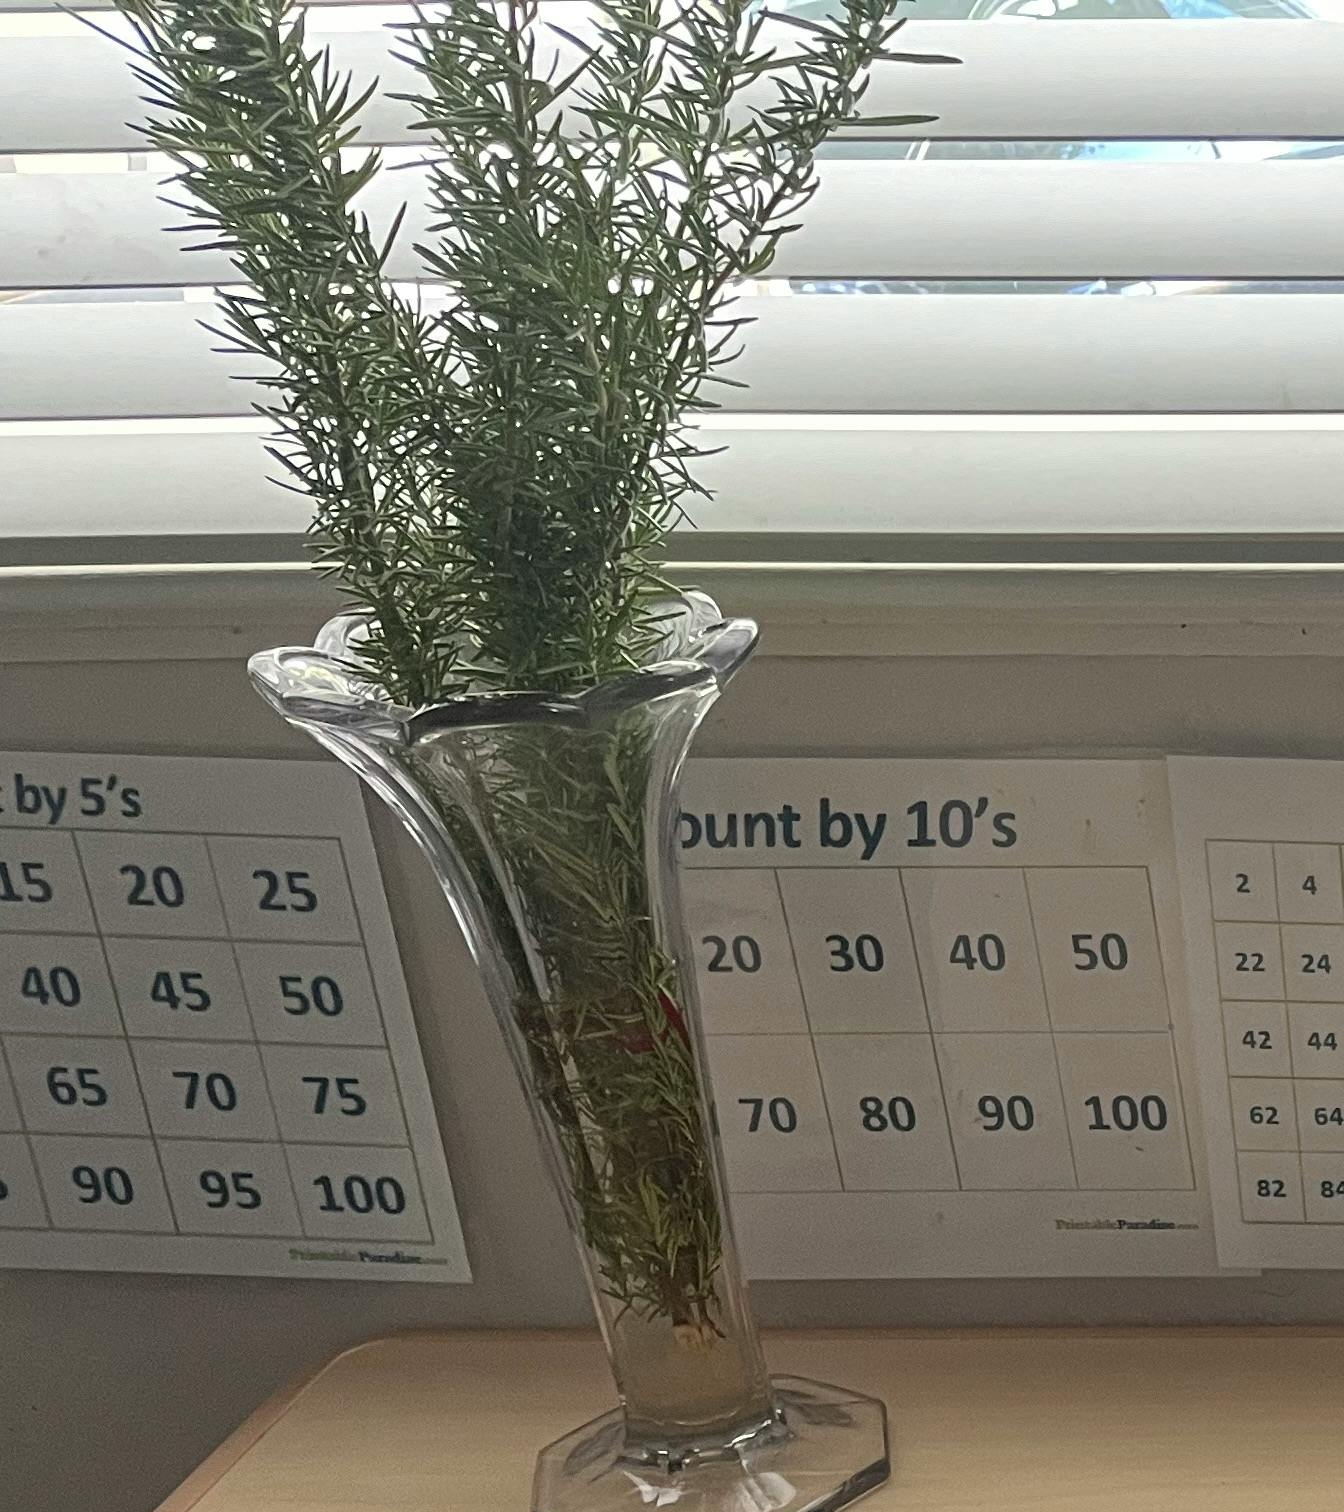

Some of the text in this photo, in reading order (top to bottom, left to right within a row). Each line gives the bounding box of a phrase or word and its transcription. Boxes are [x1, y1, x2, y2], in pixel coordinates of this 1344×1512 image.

[15, 773, 67, 825] by
[81, 775, 141, 818] 5's
[679, 797, 1016, 860] ount by 10's
[0, 862, 317, 912] 15 20 25
[1236, 873, 1250, 893] 2
[1302, 875, 1317, 895] 4
[702, 933, 1127, 972] 20 30 40 50
[1235, 952, 1265, 972] 22
[1302, 954, 1331, 973] 24
[22, 967, 343, 1016] 40 45 50
[47, 1067, 366, 1116] 65 70 75
[738, 1095, 1167, 1133] 70 80 90 100
[72, 1166, 405, 1214] 90 95 100
[1257, 1180, 1286, 1197] 82
